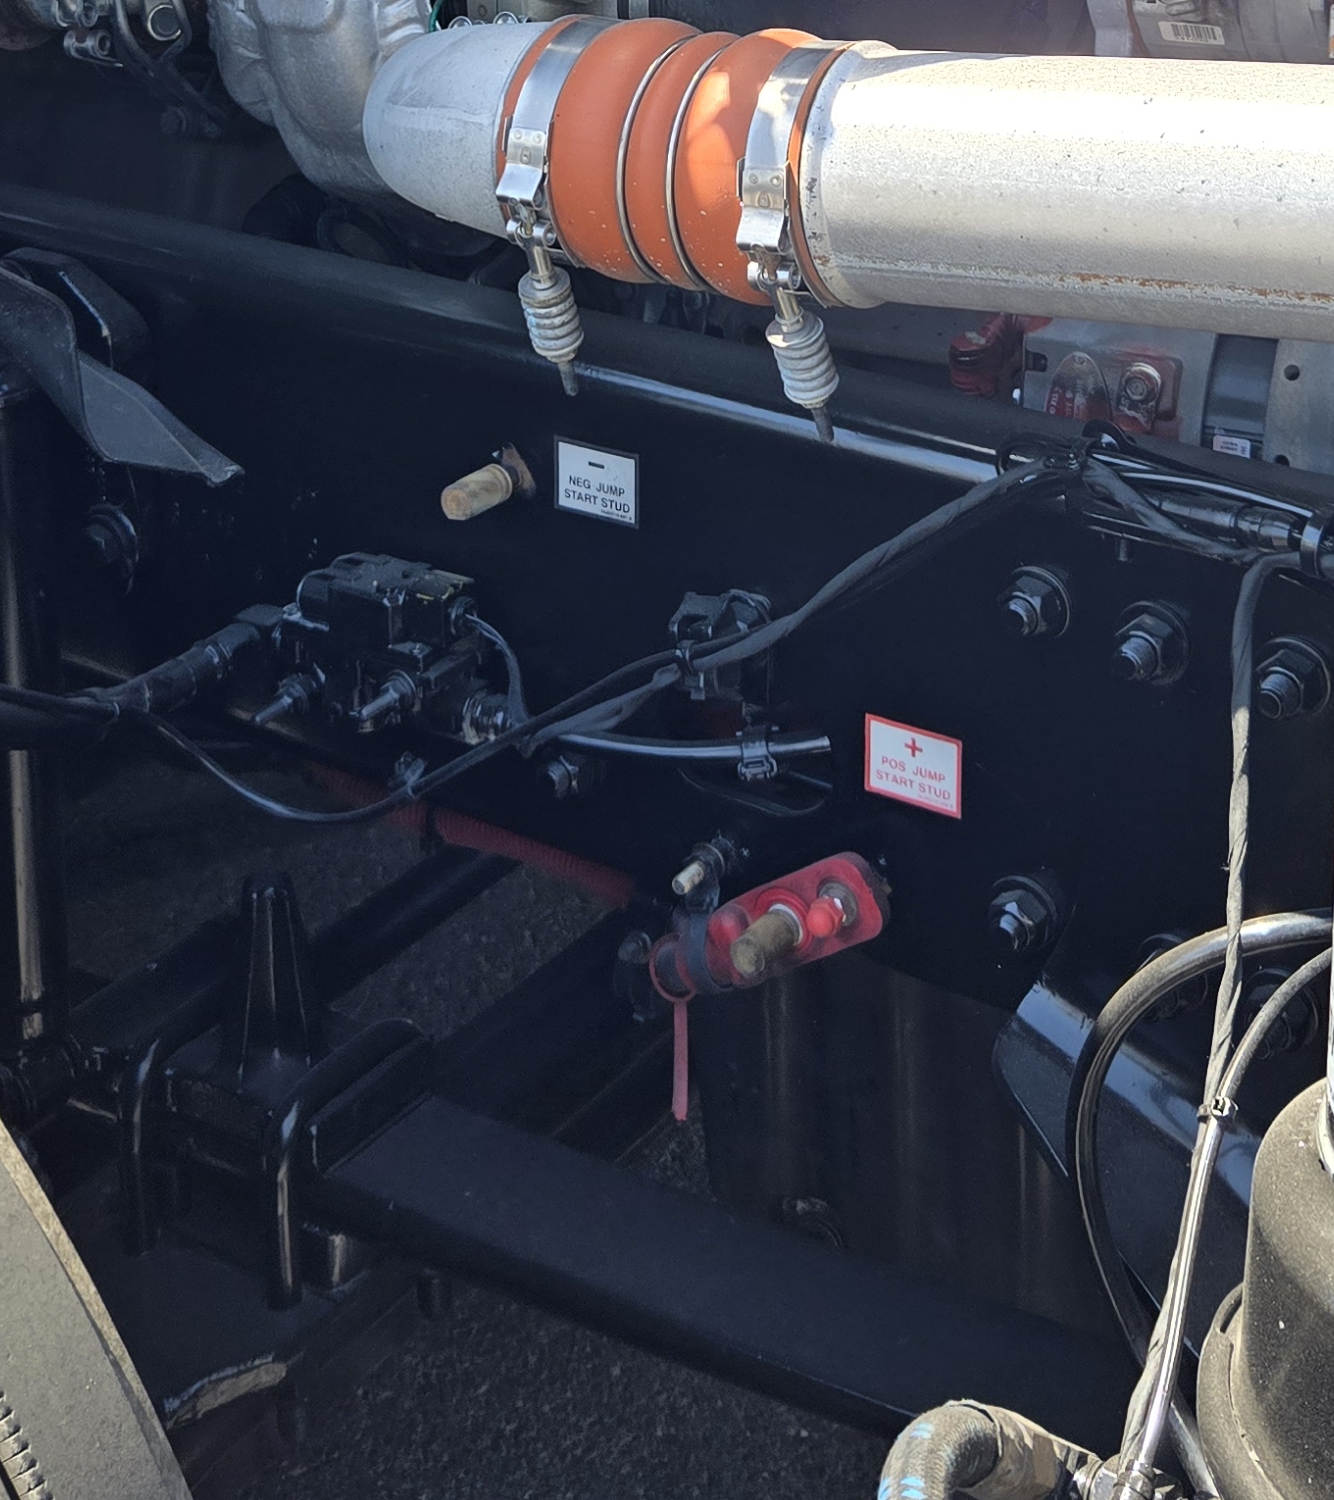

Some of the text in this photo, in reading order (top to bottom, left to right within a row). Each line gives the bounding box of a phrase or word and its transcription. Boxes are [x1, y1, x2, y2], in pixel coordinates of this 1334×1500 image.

[569, 474, 625, 497] NEG JUMP
[564, 488, 630, 514] START STUD
[881, 756, 946, 783] POS JUMP
[875, 769, 951, 801] START STUD
